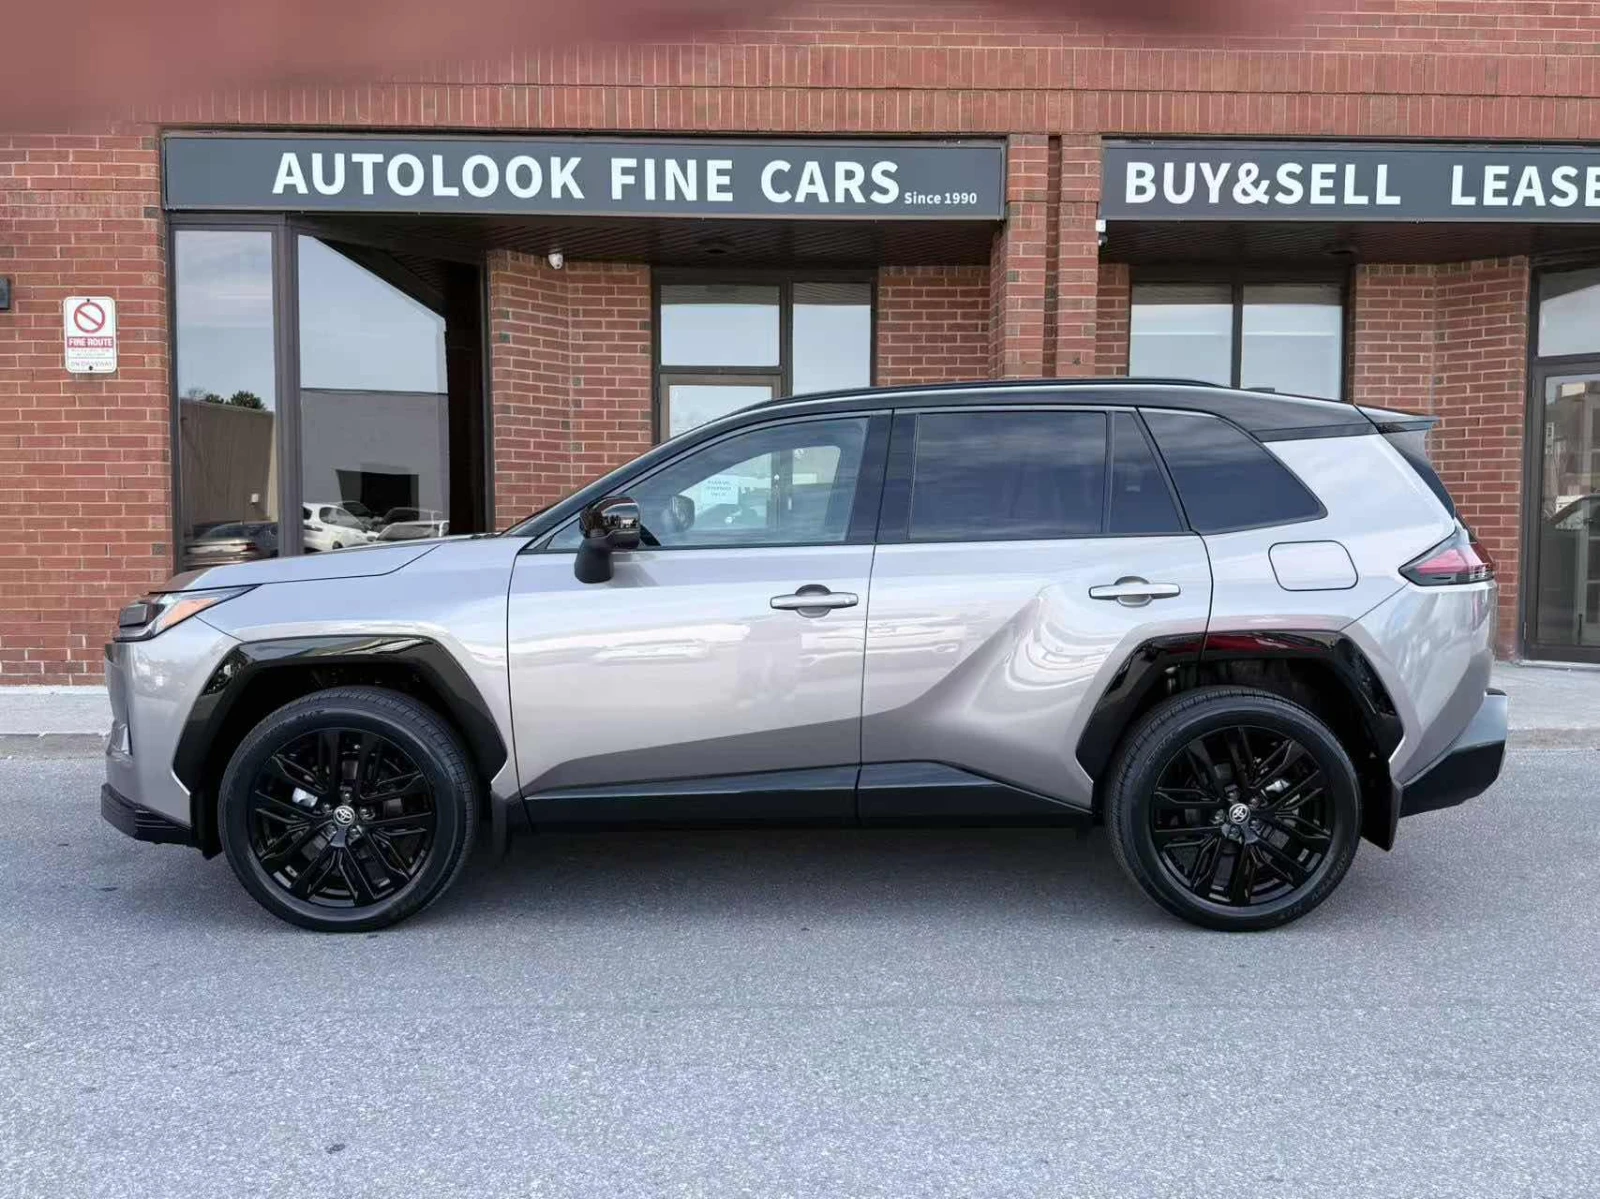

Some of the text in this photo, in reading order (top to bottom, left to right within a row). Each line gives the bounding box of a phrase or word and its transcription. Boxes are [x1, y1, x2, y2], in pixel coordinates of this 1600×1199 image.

[271, 152, 978, 205] AUTOLOOK FINE CARS Since 1990
[1125, 161, 1401, 206] BUY&SELL
